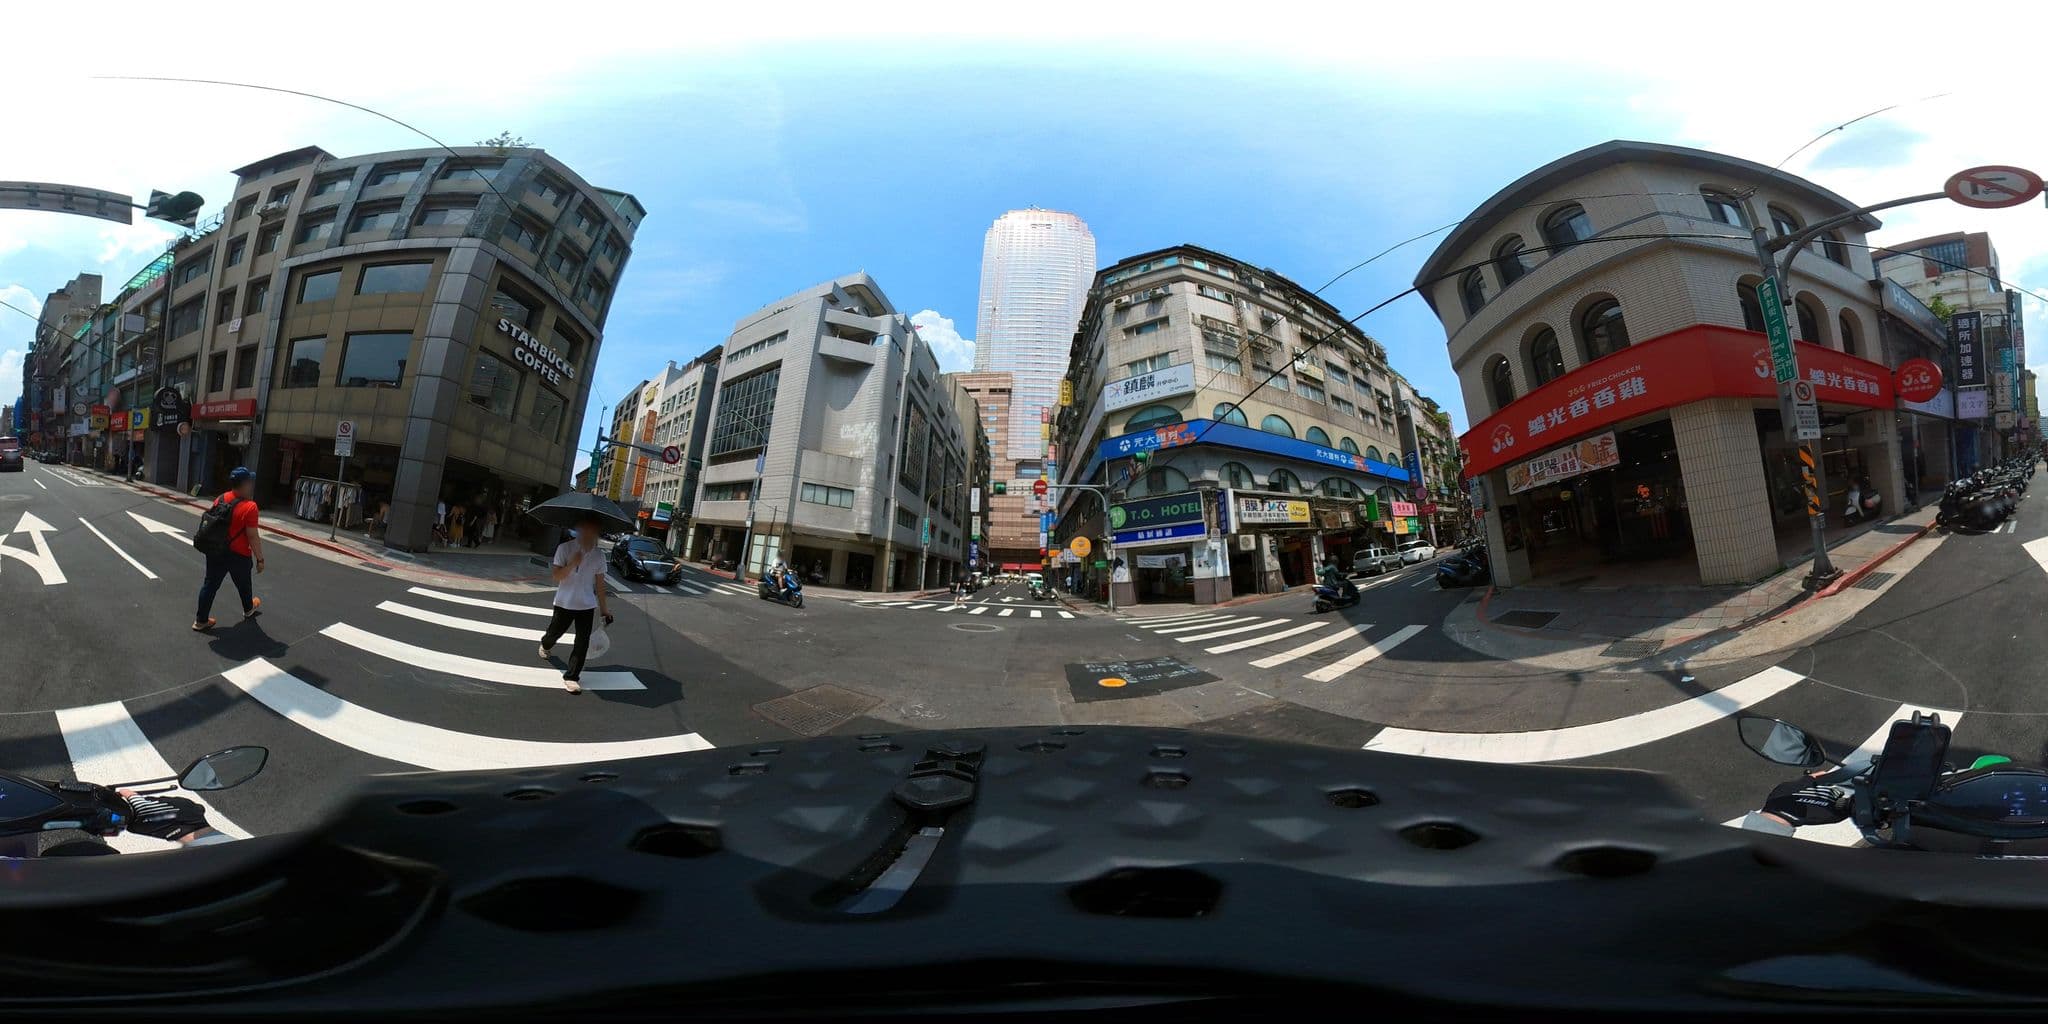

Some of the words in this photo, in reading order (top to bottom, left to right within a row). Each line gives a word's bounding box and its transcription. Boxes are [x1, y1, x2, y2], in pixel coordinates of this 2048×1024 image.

[498, 318, 576, 379] STARBUCKS
[514, 346, 561, 386] COFFEE
[1608, 364, 1641, 381] CHICKEN
[1902, 371, 1931, 386] J&G
[1527, 376, 1647, 438] 繼光香香雞
[1130, 508, 1154, 521] T.O.
[1161, 502, 1202, 517] HOTEL
